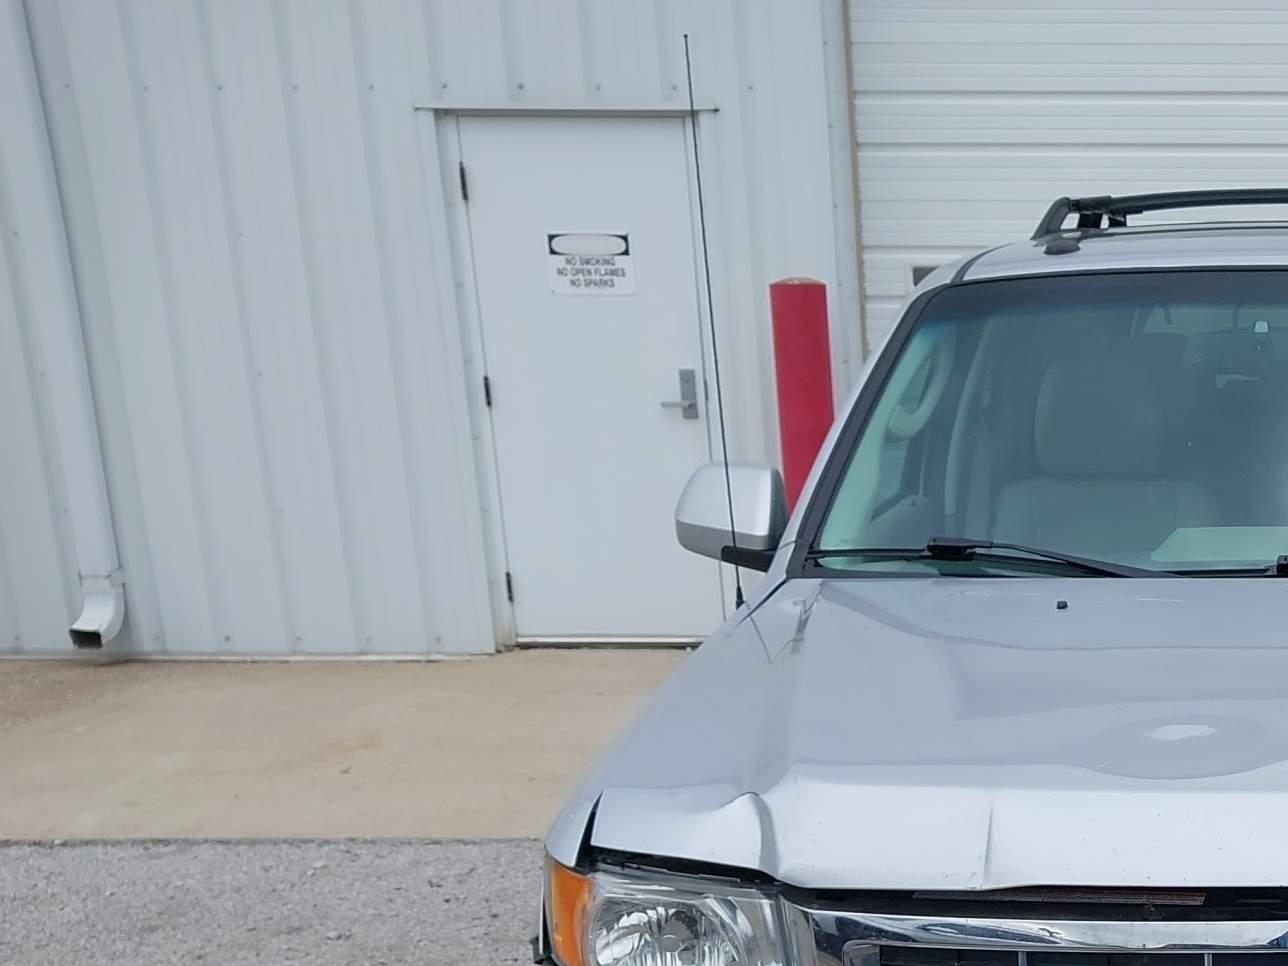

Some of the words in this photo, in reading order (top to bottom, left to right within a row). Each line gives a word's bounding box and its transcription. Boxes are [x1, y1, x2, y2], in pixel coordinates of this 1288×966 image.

[565, 256, 576, 266] NO
[579, 256, 616, 266] SMOKING
[556, 268, 568, 276] NO
[571, 267, 592, 277] OPEN
[594, 268, 626, 277] FLAMES
[569, 279, 581, 288] NO
[583, 279, 615, 288] SPARKS
